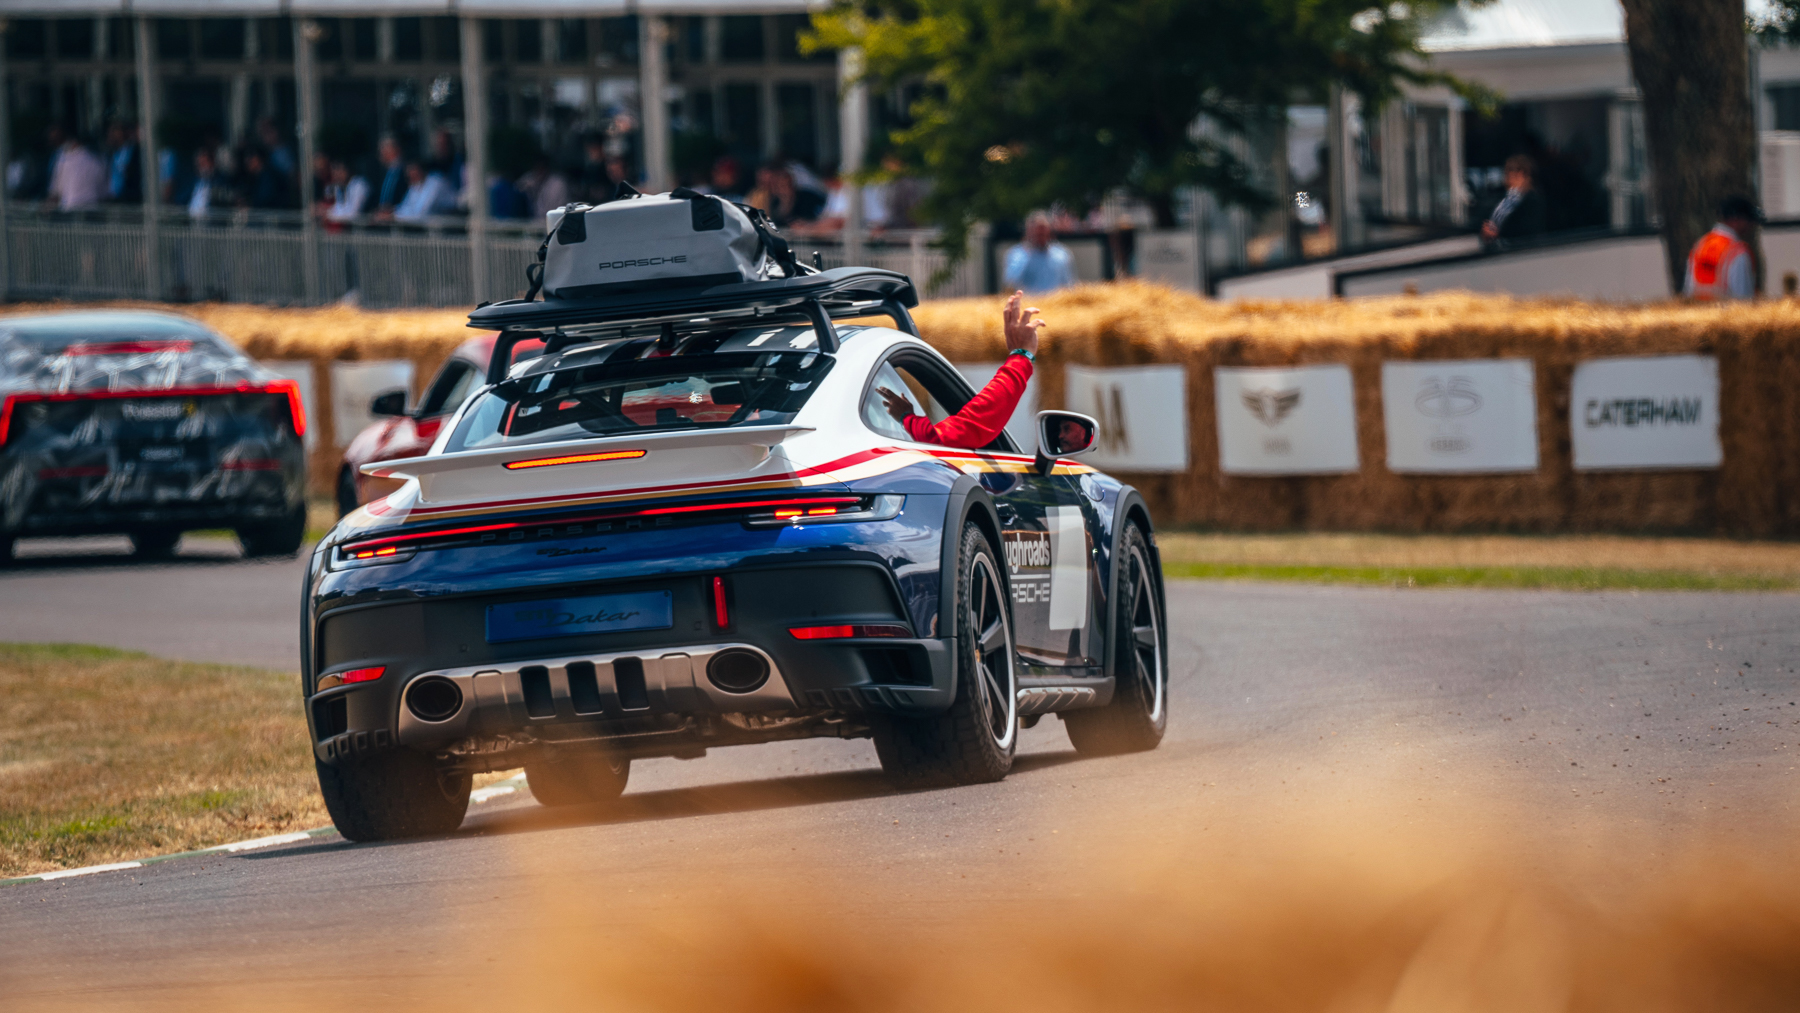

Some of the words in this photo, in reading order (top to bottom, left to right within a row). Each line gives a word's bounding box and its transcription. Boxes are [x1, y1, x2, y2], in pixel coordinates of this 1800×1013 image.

[599, 255, 687, 270] PORSCHE
[1585, 397, 1701, 428] CATERHAM
[480, 516, 673, 543] PORSCHE
[1004, 532, 1050, 574] ughroads
[1011, 582, 1050, 603] RSCHE
[537, 609, 640, 628] Dakar
